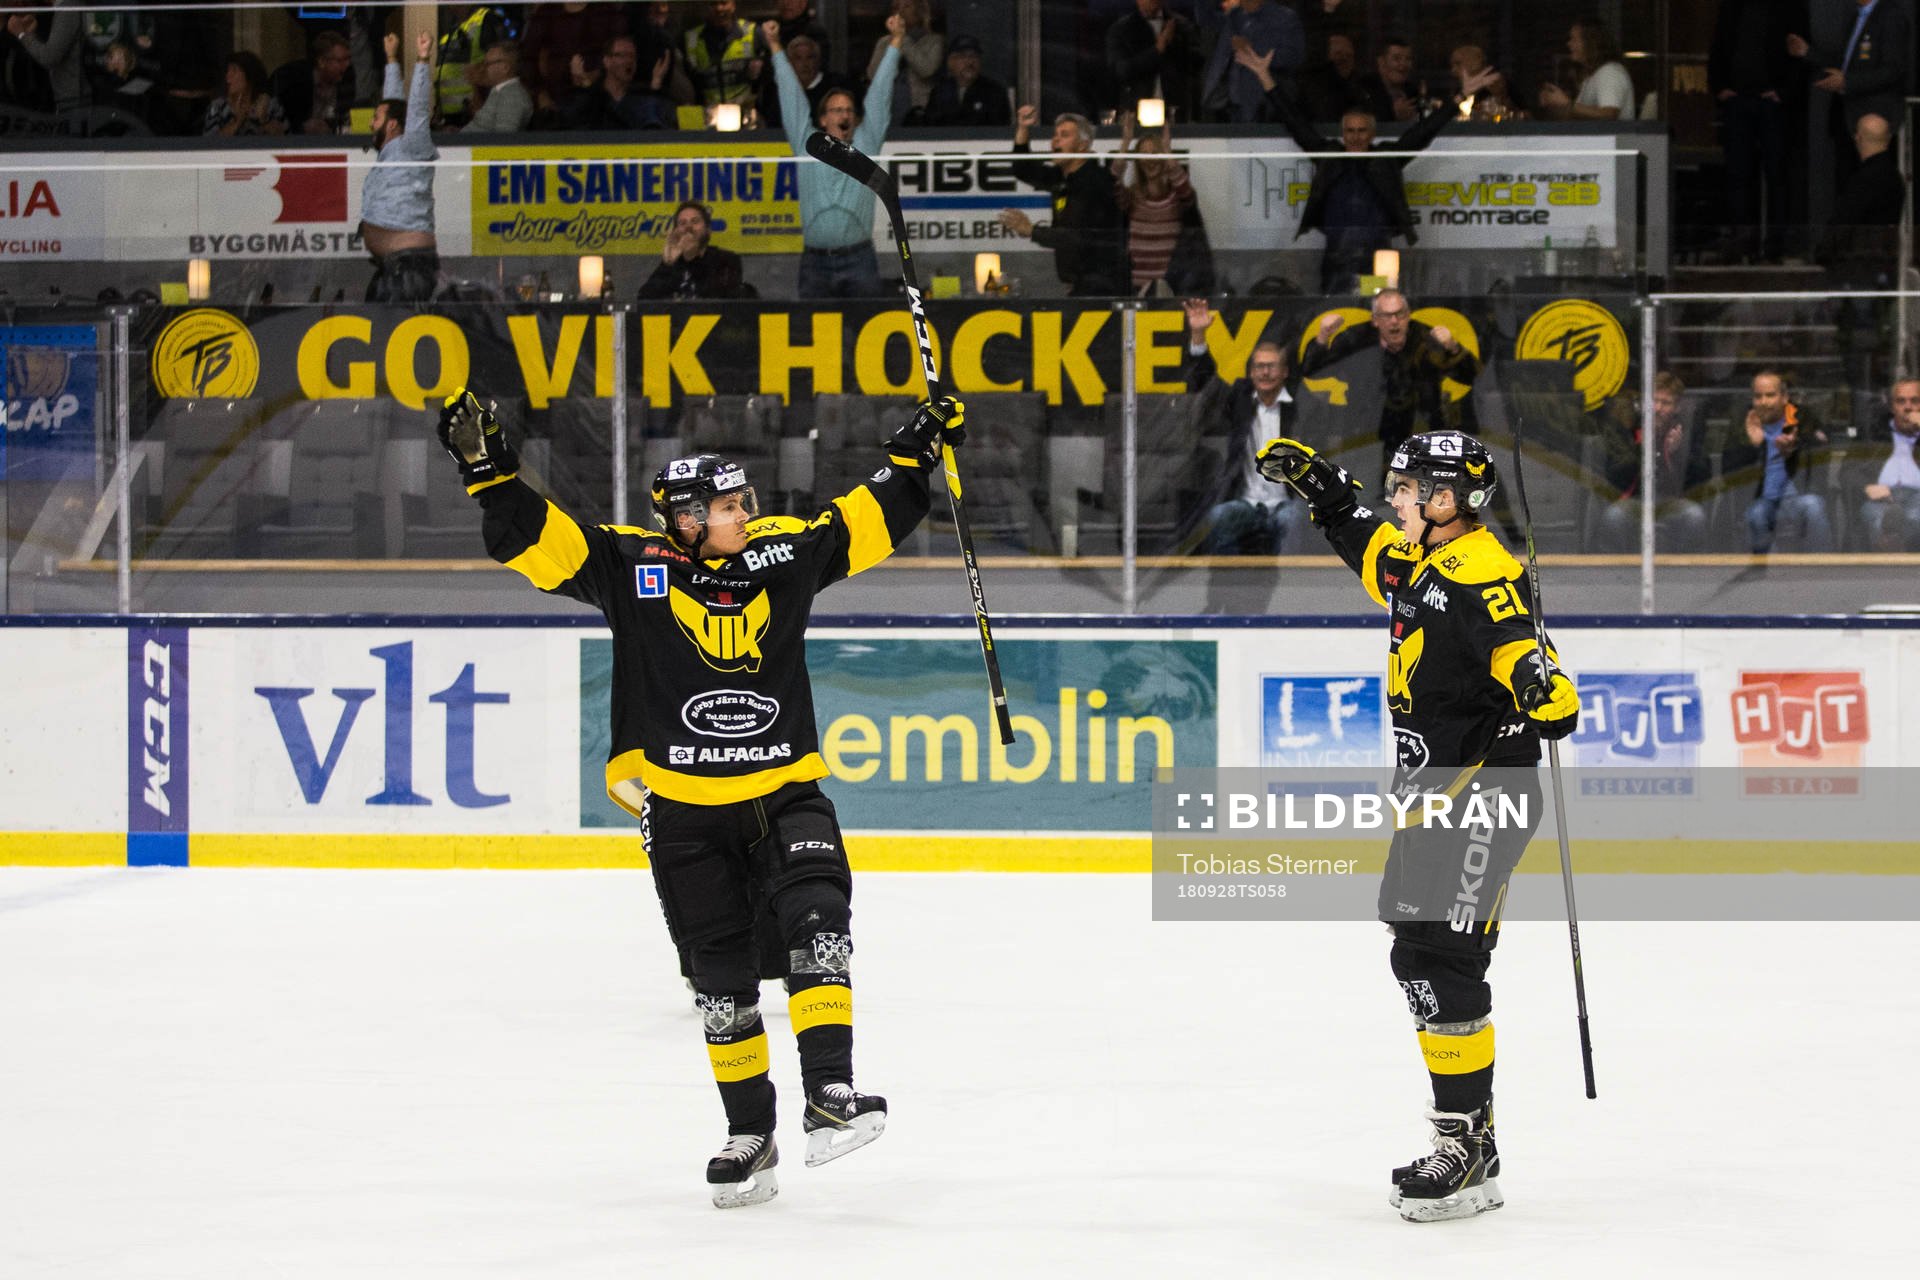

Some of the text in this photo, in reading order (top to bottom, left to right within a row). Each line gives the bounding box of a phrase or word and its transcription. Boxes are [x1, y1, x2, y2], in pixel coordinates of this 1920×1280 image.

[488, 157, 546, 204] EM
[557, 156, 763, 203] SANERING
[907, 285, 939, 383] CCM
[297, 314, 470, 411] GO
[507, 314, 722, 410] VIK
[758, 309, 1274, 408] HOCKEY
[670, 492, 692, 502] CCM
[742, 542, 796, 572] Britt
[968, 566, 989, 616] TACKS
[1481, 583, 1530, 624] 21
[143, 638, 171, 817] CCM
[253, 640, 511, 809] vlt
[1276, 678, 1367, 749] LF
[1578, 694, 1693, 749] HJT
[1736, 694, 1858, 748] HJT
[698, 742, 792, 762] ALFAGLAS
[1589, 779, 1685, 795] SERVICE
[789, 840, 835, 852] CCM
[1446, 785, 1503, 935] ŠKODA
[822, 975, 846, 984] CCM
[823, 1102, 841, 1110] CCM
